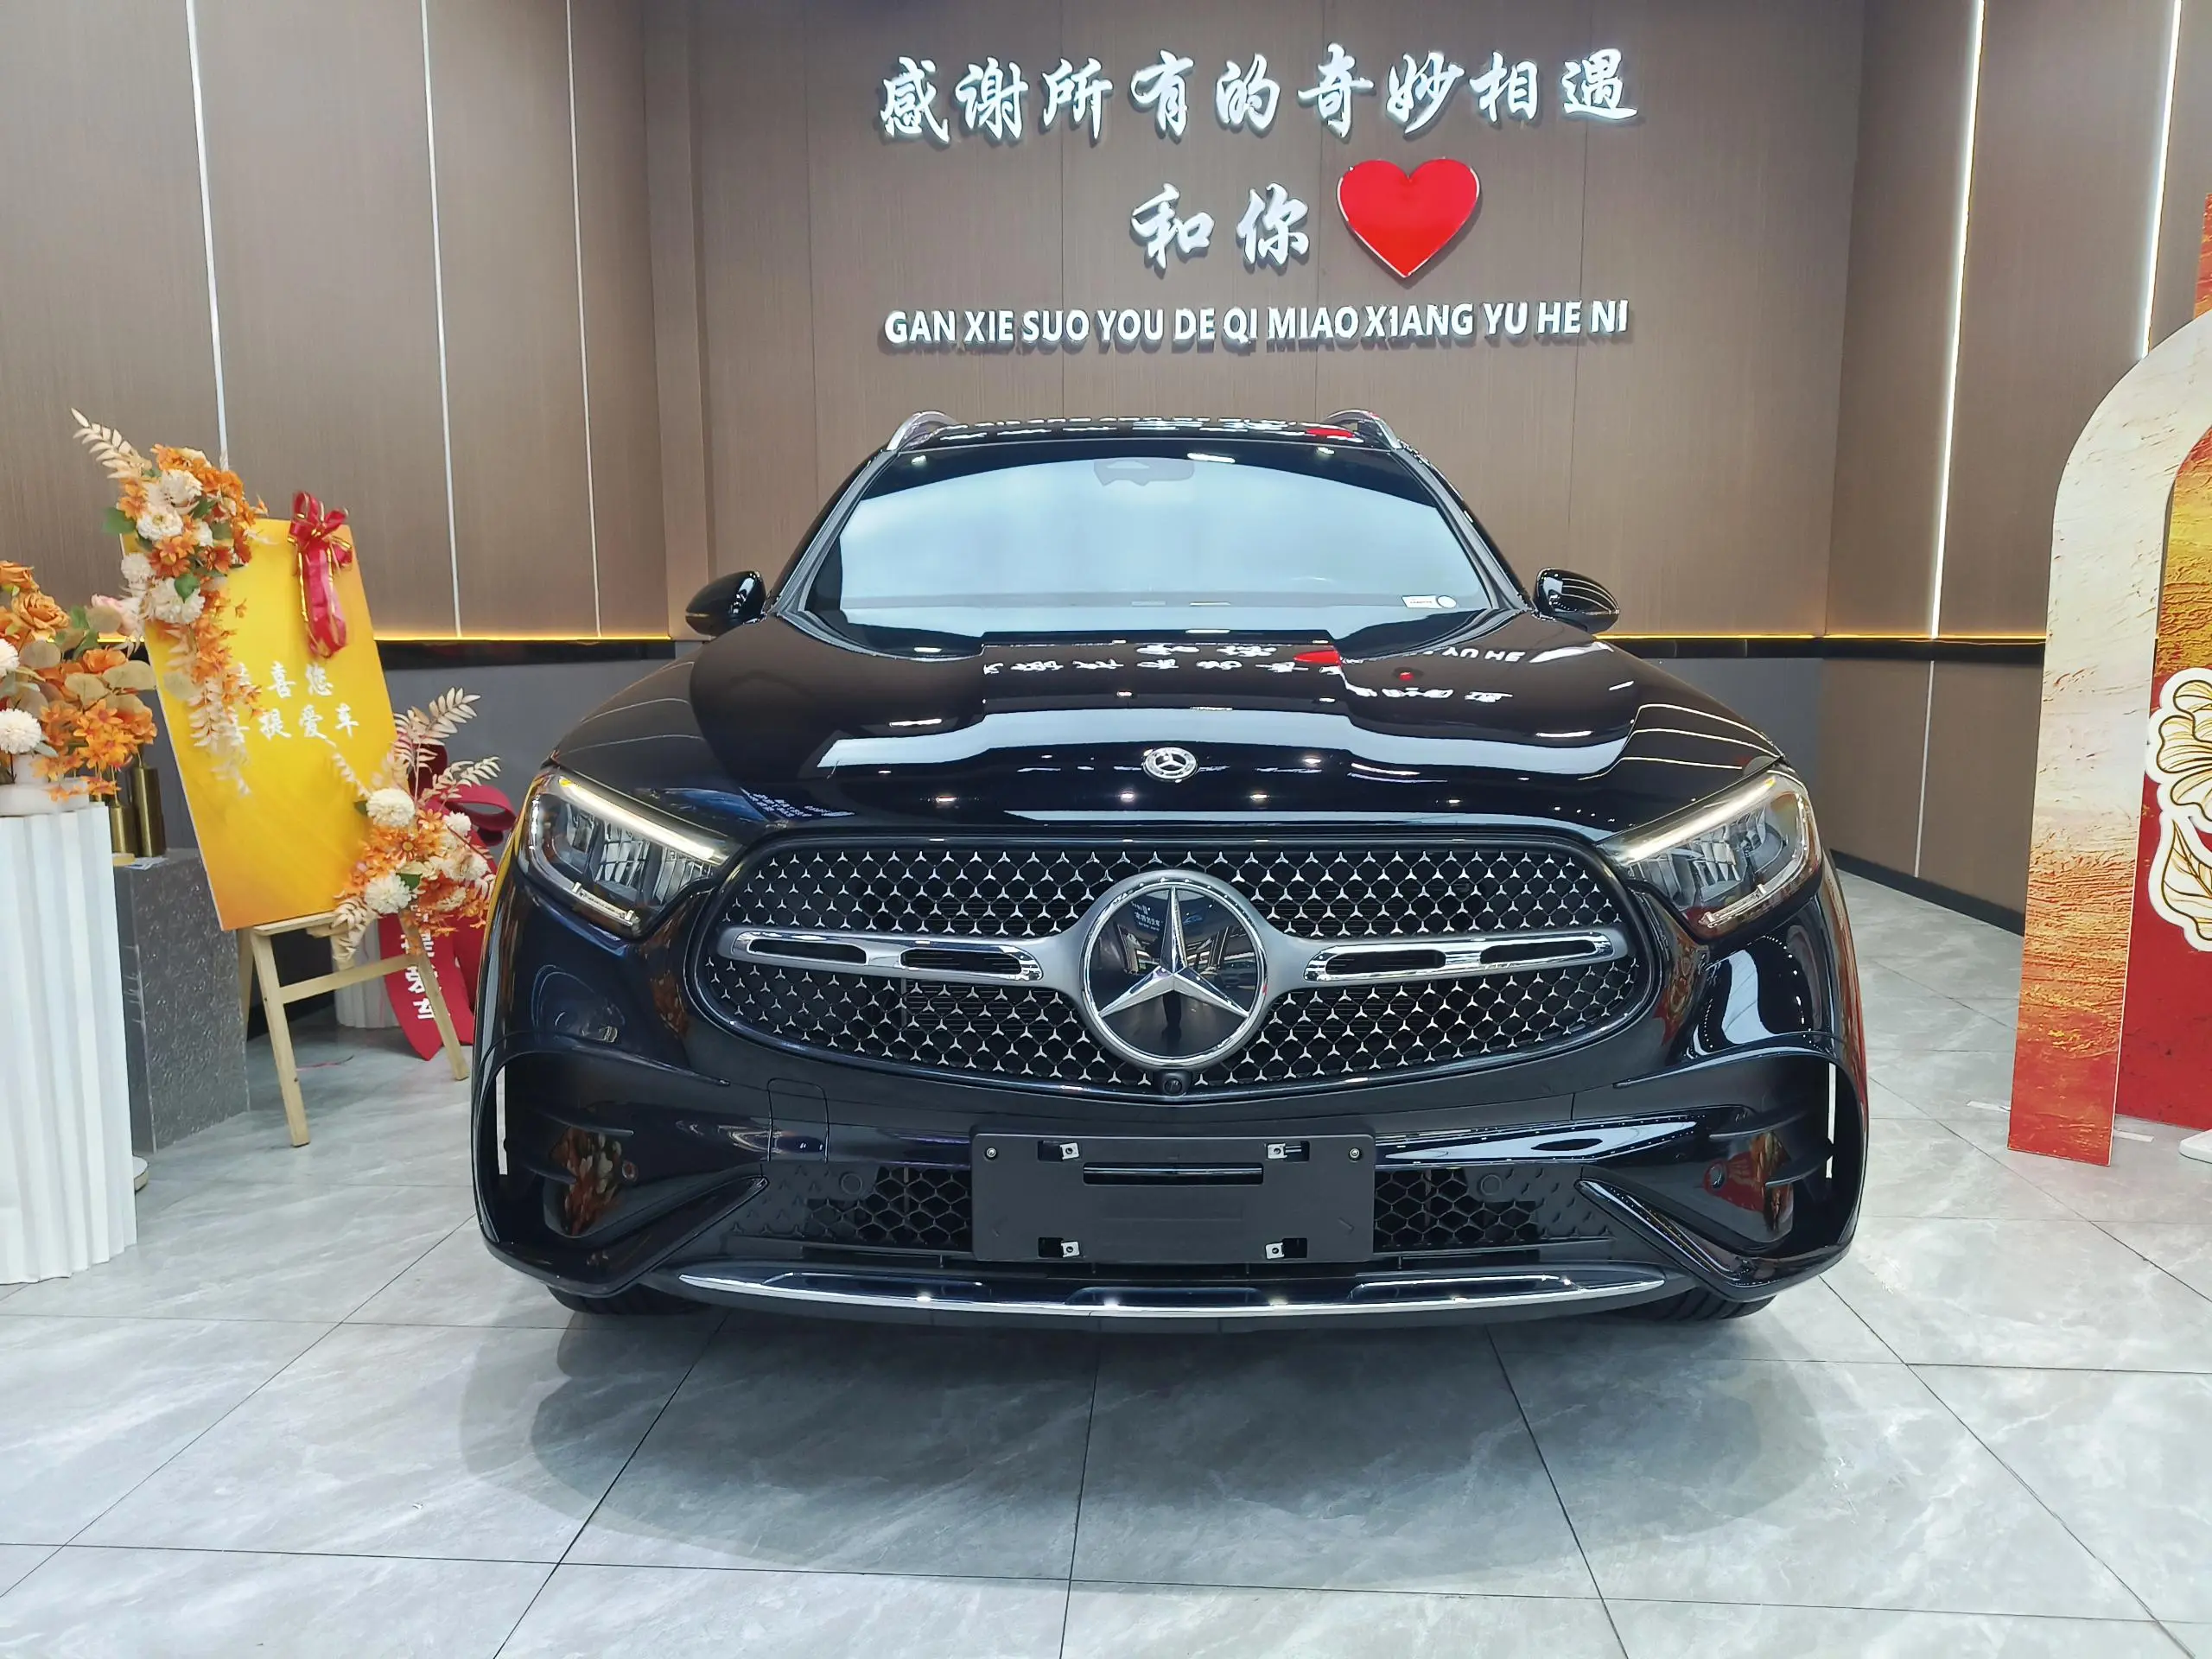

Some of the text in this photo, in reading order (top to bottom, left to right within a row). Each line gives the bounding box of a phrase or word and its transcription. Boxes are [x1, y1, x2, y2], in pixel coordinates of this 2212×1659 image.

[880, 43, 1638, 143] 感谢所有的奇妙相遇
[1131, 182, 1310, 269] 和你
[885, 299, 1629, 344] GAN XIE SUO YOU DE QI MIAO XIANG YU HE NI
